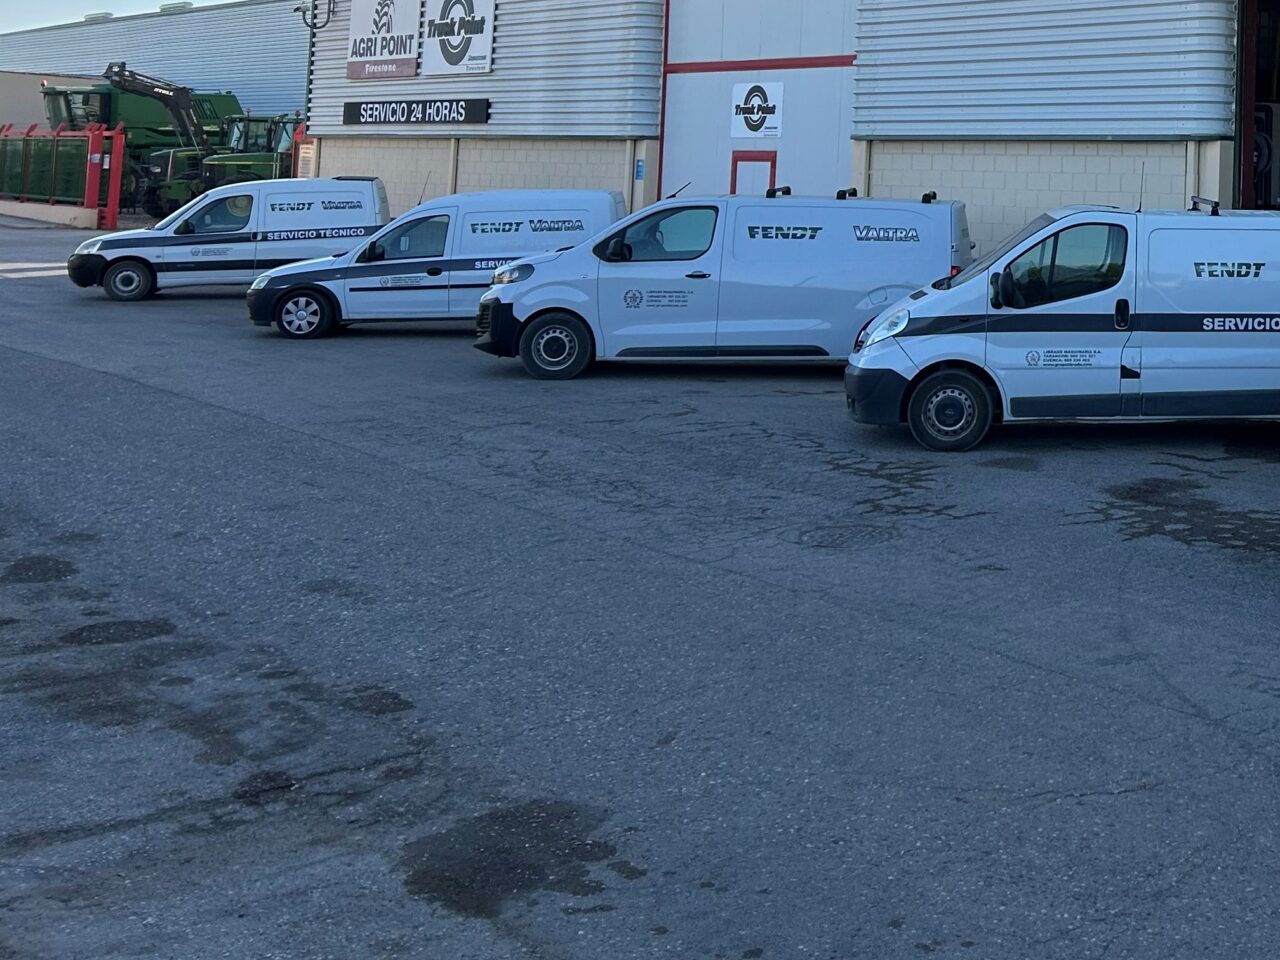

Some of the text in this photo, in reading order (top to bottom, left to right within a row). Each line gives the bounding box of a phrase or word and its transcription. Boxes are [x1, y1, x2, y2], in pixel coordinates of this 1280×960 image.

[427, 14, 486, 39] Truck Point
[350, 34, 414, 58] AGRI POINT
[365, 63, 396, 75] Firestone
[360, 101, 466, 123] SERVICIO 24 HORAS
[270, 202, 315, 212] FENDT
[267, 227, 365, 240] SERVICIO TÉCNICO
[470, 219, 585, 233] FENDT VALTRA
[747, 225, 920, 242] FENDT VALTRA
[474, 259, 514, 269] SERVIC
[1193, 262, 1266, 278] FENDT
